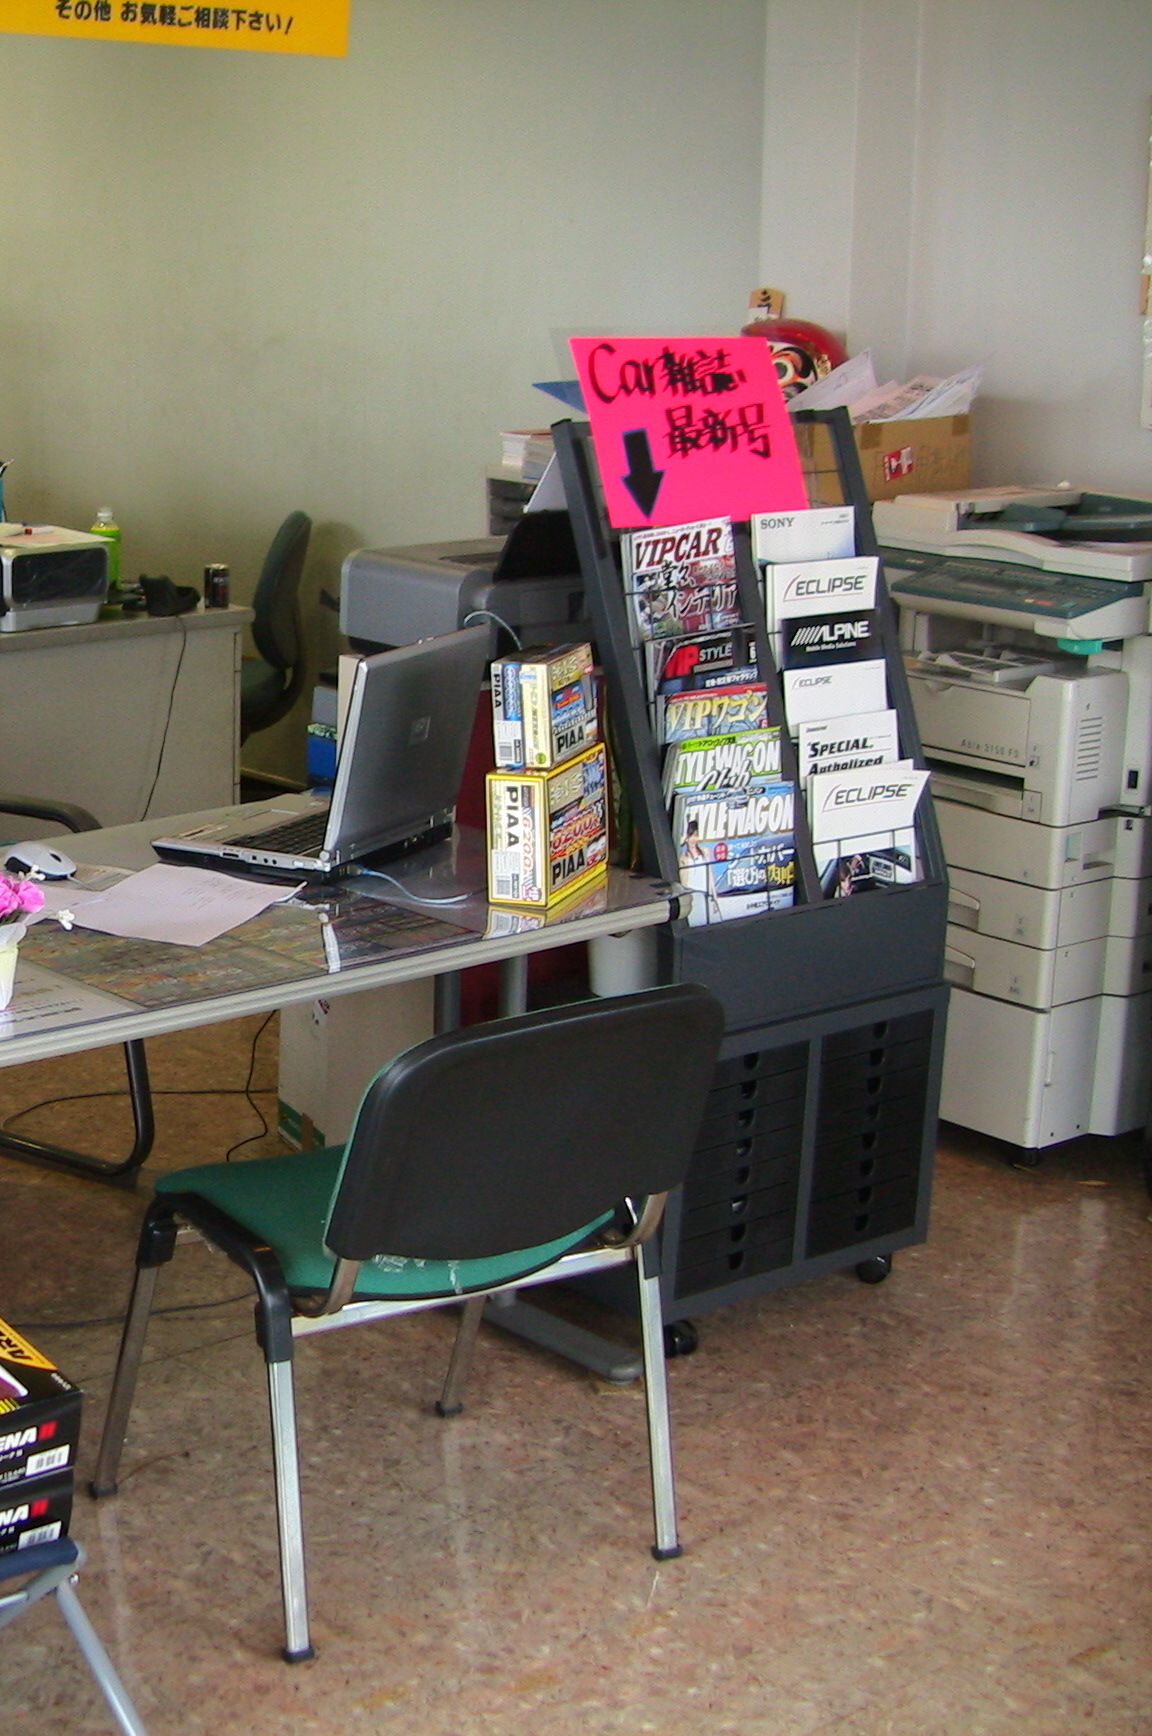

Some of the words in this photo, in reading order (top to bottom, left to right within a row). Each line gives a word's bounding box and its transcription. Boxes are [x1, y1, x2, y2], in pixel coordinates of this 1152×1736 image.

[662, 403, 772, 460] 最新号
[760, 517, 795, 530] SONY
[634, 526, 723, 571] VIPCAR
[794, 574, 868, 597] ECLIPSE
[814, 620, 871, 643] ALPINE
[699, 641, 733, 662] STYLE
[493, 673, 502, 709] PIAA
[798, 674, 833, 688] ECLIPSE
[667, 689, 768, 735] VIPワゴン
[557, 725, 585, 754] PIAA
[833, 783, 915, 806] ECLIPSE
[505, 785, 520, 848] PIAA
[552, 848, 586, 886] PIAA
